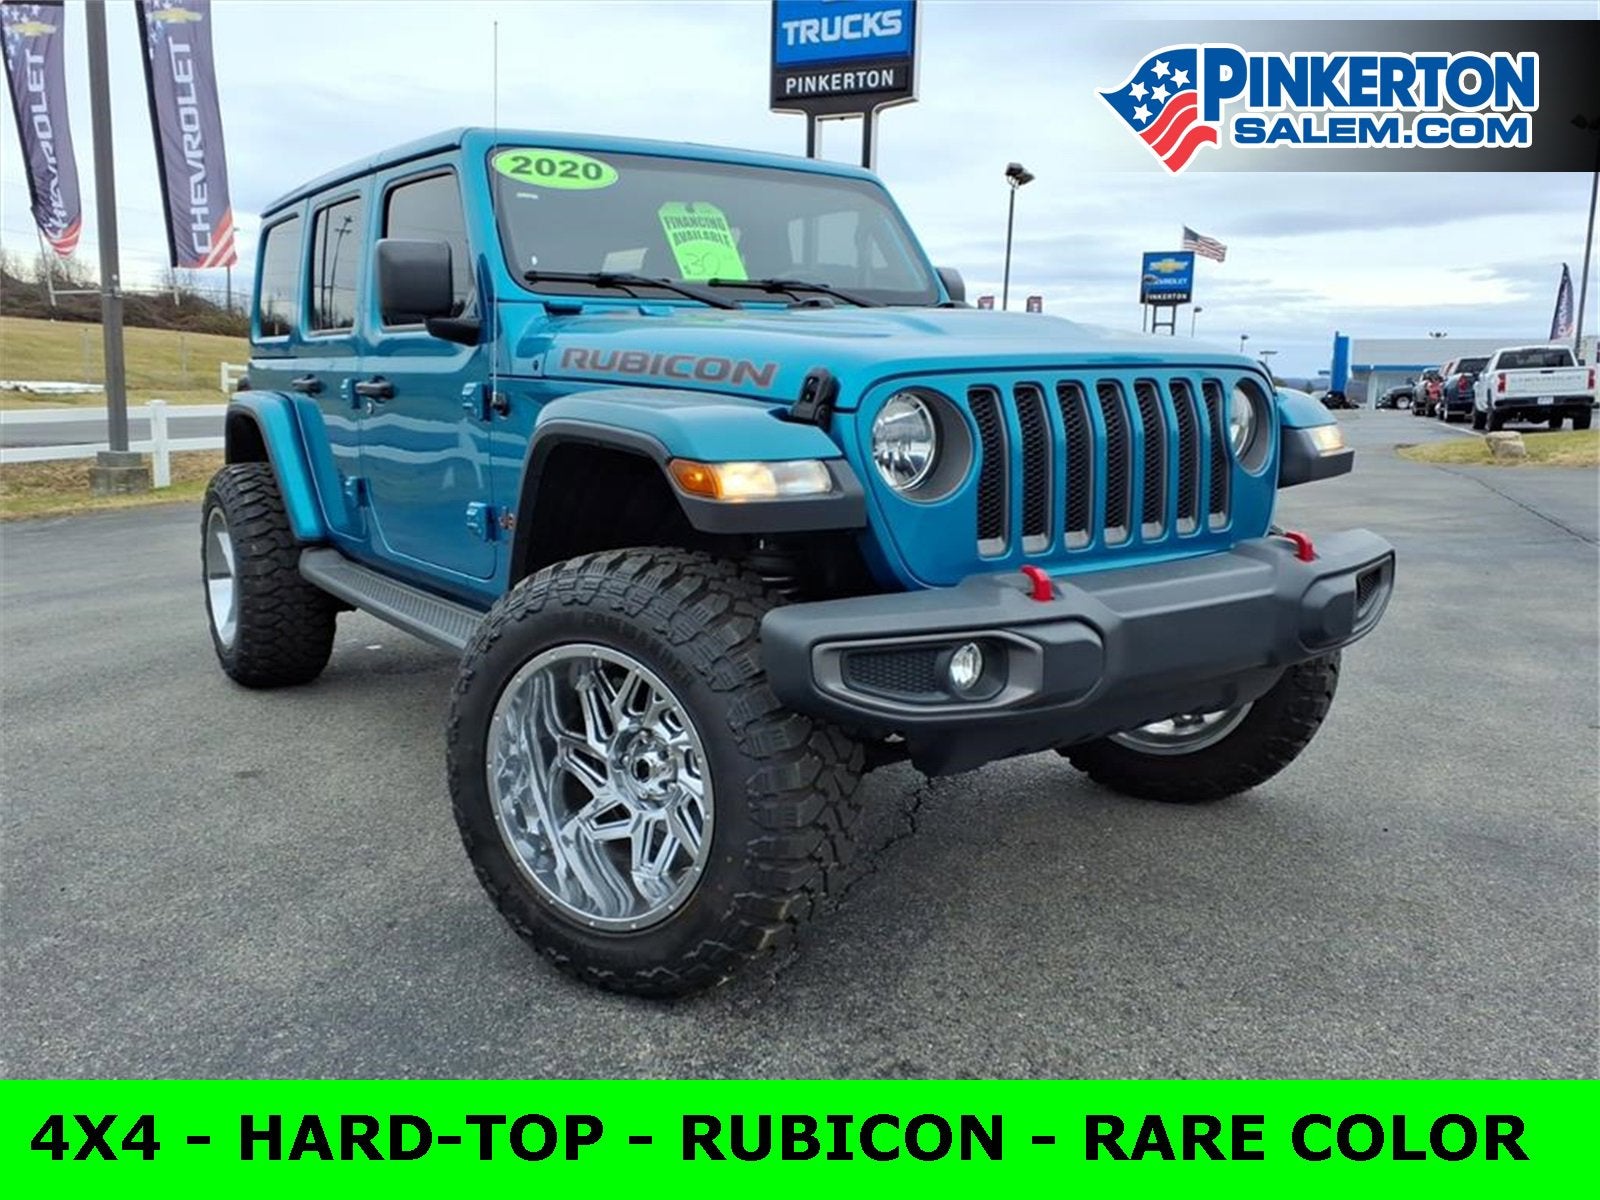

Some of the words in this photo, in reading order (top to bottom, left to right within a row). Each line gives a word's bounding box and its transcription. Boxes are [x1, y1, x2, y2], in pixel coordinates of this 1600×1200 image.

[781, 9, 903, 46] TRUCKS
[785, 69, 894, 94] PINKERTON
[168, 36, 212, 254] CHEVROLET
[510, 156, 603, 180] 2020
[663, 215, 727, 232] FINANCING
[671, 229, 732, 248] AVAILABLE
[560, 347, 778, 387] RUBICON
